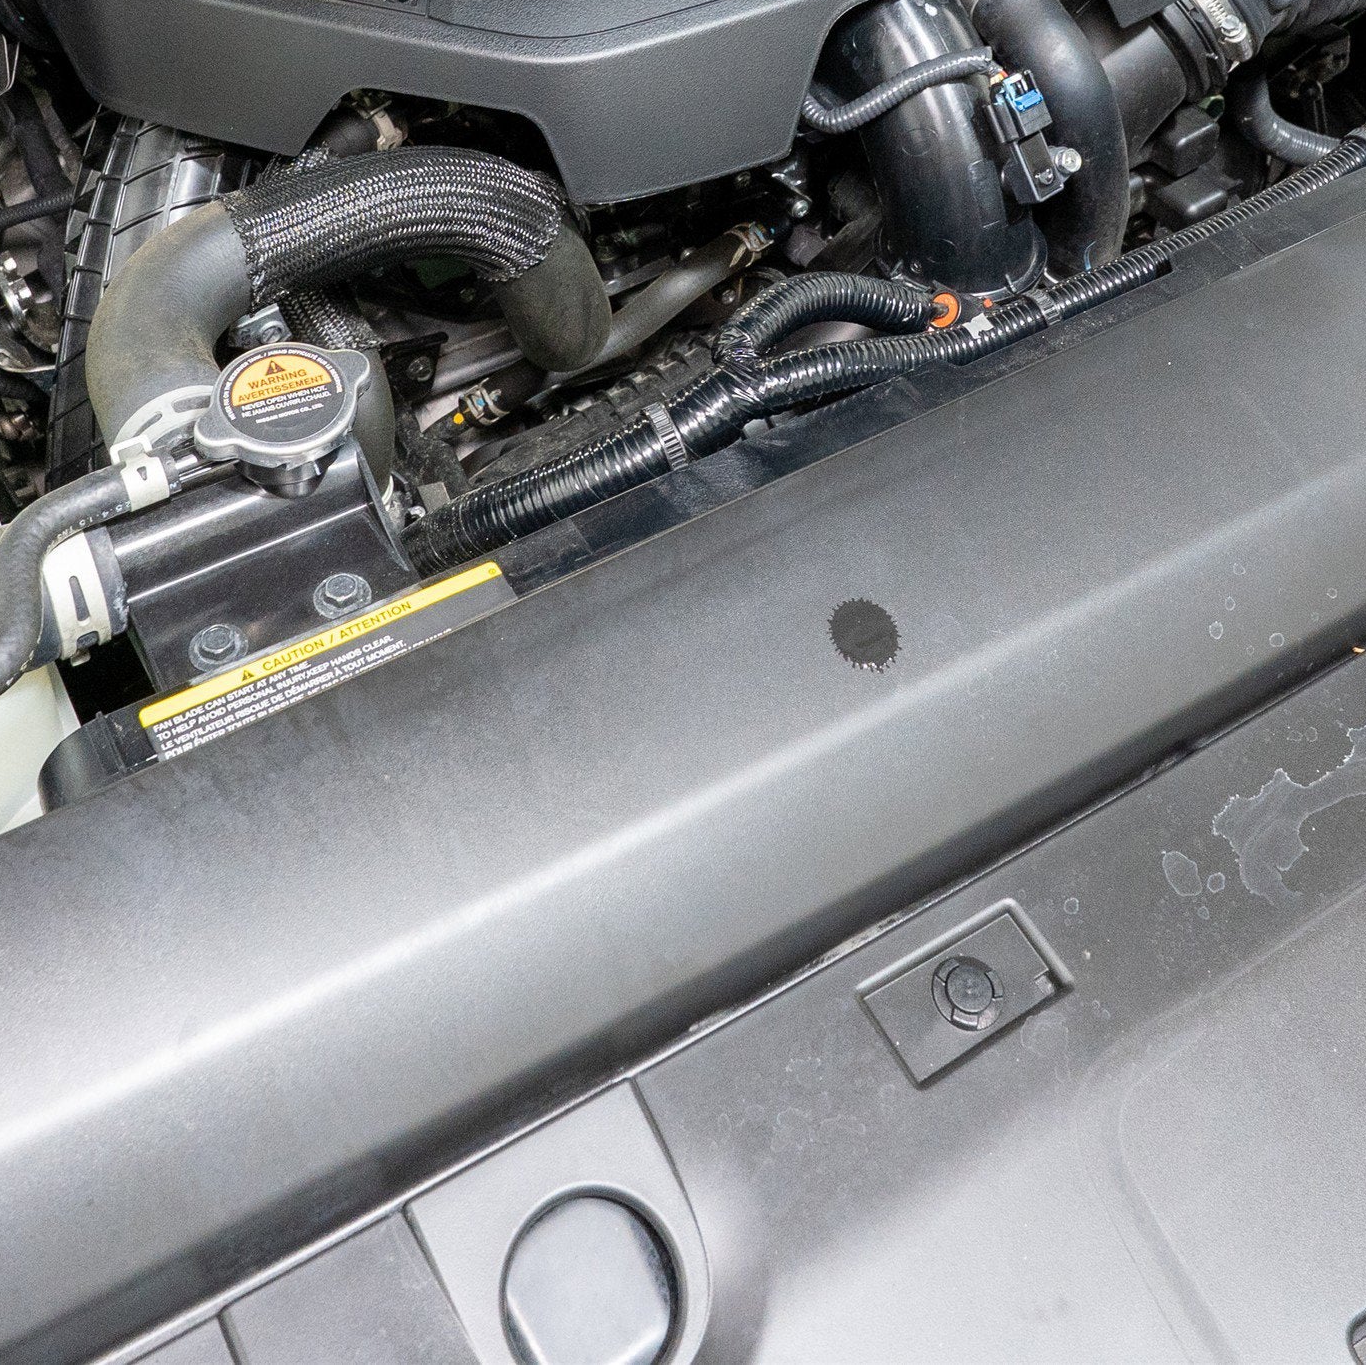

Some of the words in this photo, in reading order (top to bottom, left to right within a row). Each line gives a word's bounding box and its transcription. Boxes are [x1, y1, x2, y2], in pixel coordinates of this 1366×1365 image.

[238, 375, 324, 402] AVERTISSEMENT
[241, 401, 266, 411] NEVER
[266, 396, 287, 406] OPEN
[287, 390, 310, 401] WHEN
[248, 369, 307, 389] WARNING
[262, 639, 325, 671] CAUTION
[339, 601, 412, 640] ATTENTION
[153, 721, 173, 733] FAN
[173, 708, 206, 725] BLADE
[204, 696, 226, 711] CAN
[227, 685, 255, 703] START
[256, 678, 267, 690] AT
[269, 669, 288, 683] ANY
[290, 660, 312, 675] TIME.
[156, 731, 172, 742] TO
[172, 719, 198, 736] HELP
[198, 707, 227, 724] AVOID
[227, 688, 277, 712] PERSONAL
[330, 648, 362, 666] HANDS
[362, 635, 394, 655] CLEAR.
[160, 740, 175, 751] LE
[174, 714, 236, 745] VENTILATEUR
[235, 699, 271, 720] RISQUE
[270, 692, 285, 705] DE
[286, 671, 335, 697] DÉMARRER
[342, 657, 366, 673] TOUT
[366, 639, 407, 664] MOMENT.
